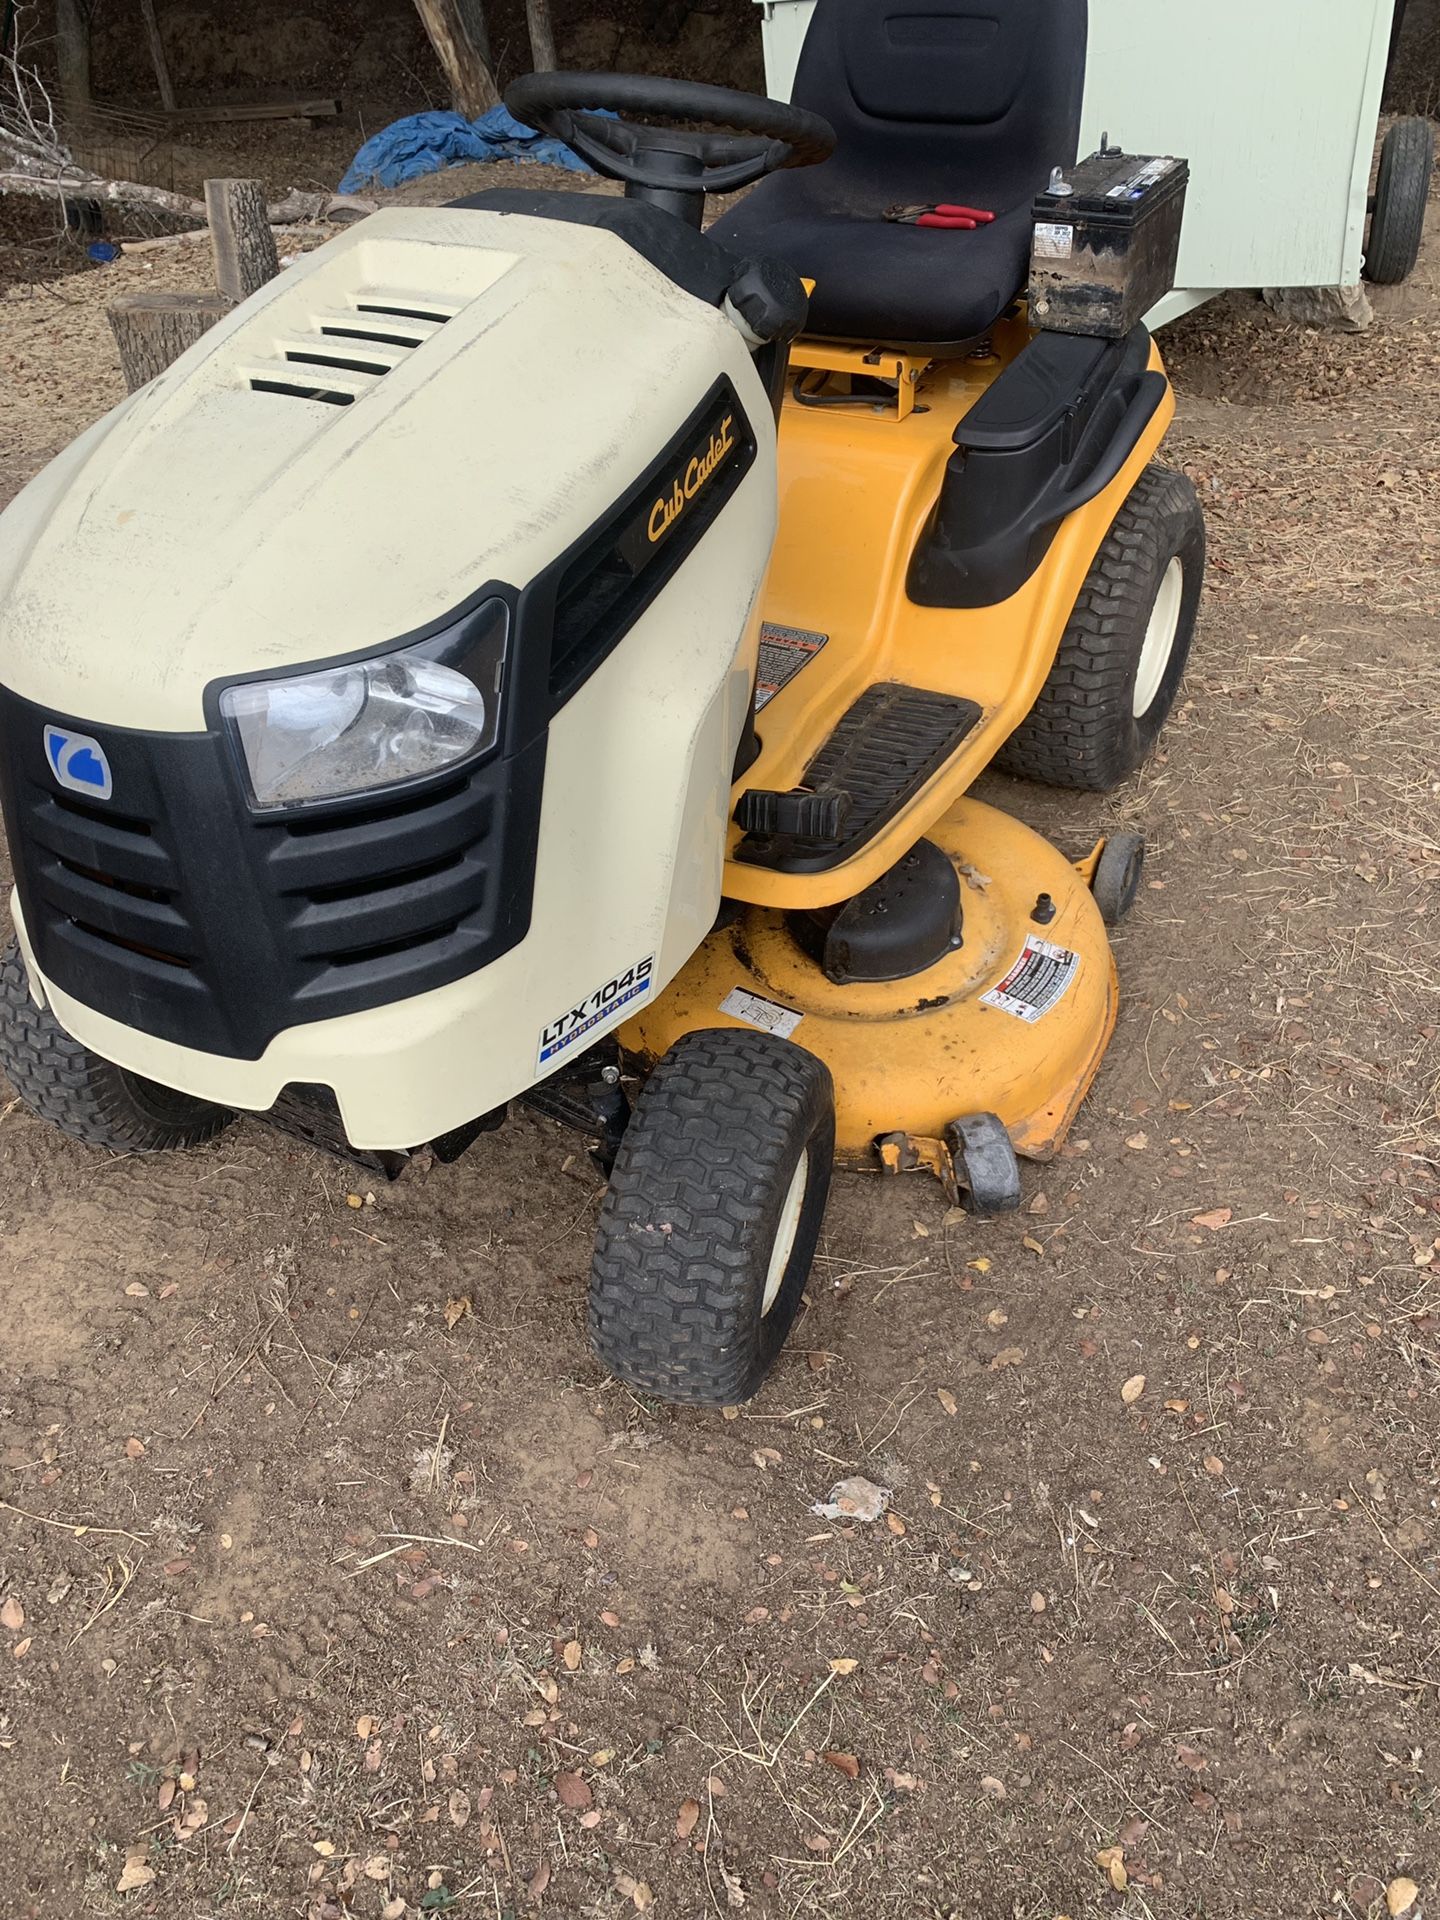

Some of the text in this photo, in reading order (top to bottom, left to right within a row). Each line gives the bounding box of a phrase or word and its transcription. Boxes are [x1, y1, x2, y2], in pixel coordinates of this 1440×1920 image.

[648, 414, 734, 542] Cub Cadet
[542, 956, 653, 1047] LTX 1045
[550, 986, 640, 1055] HYDROSTATIC
